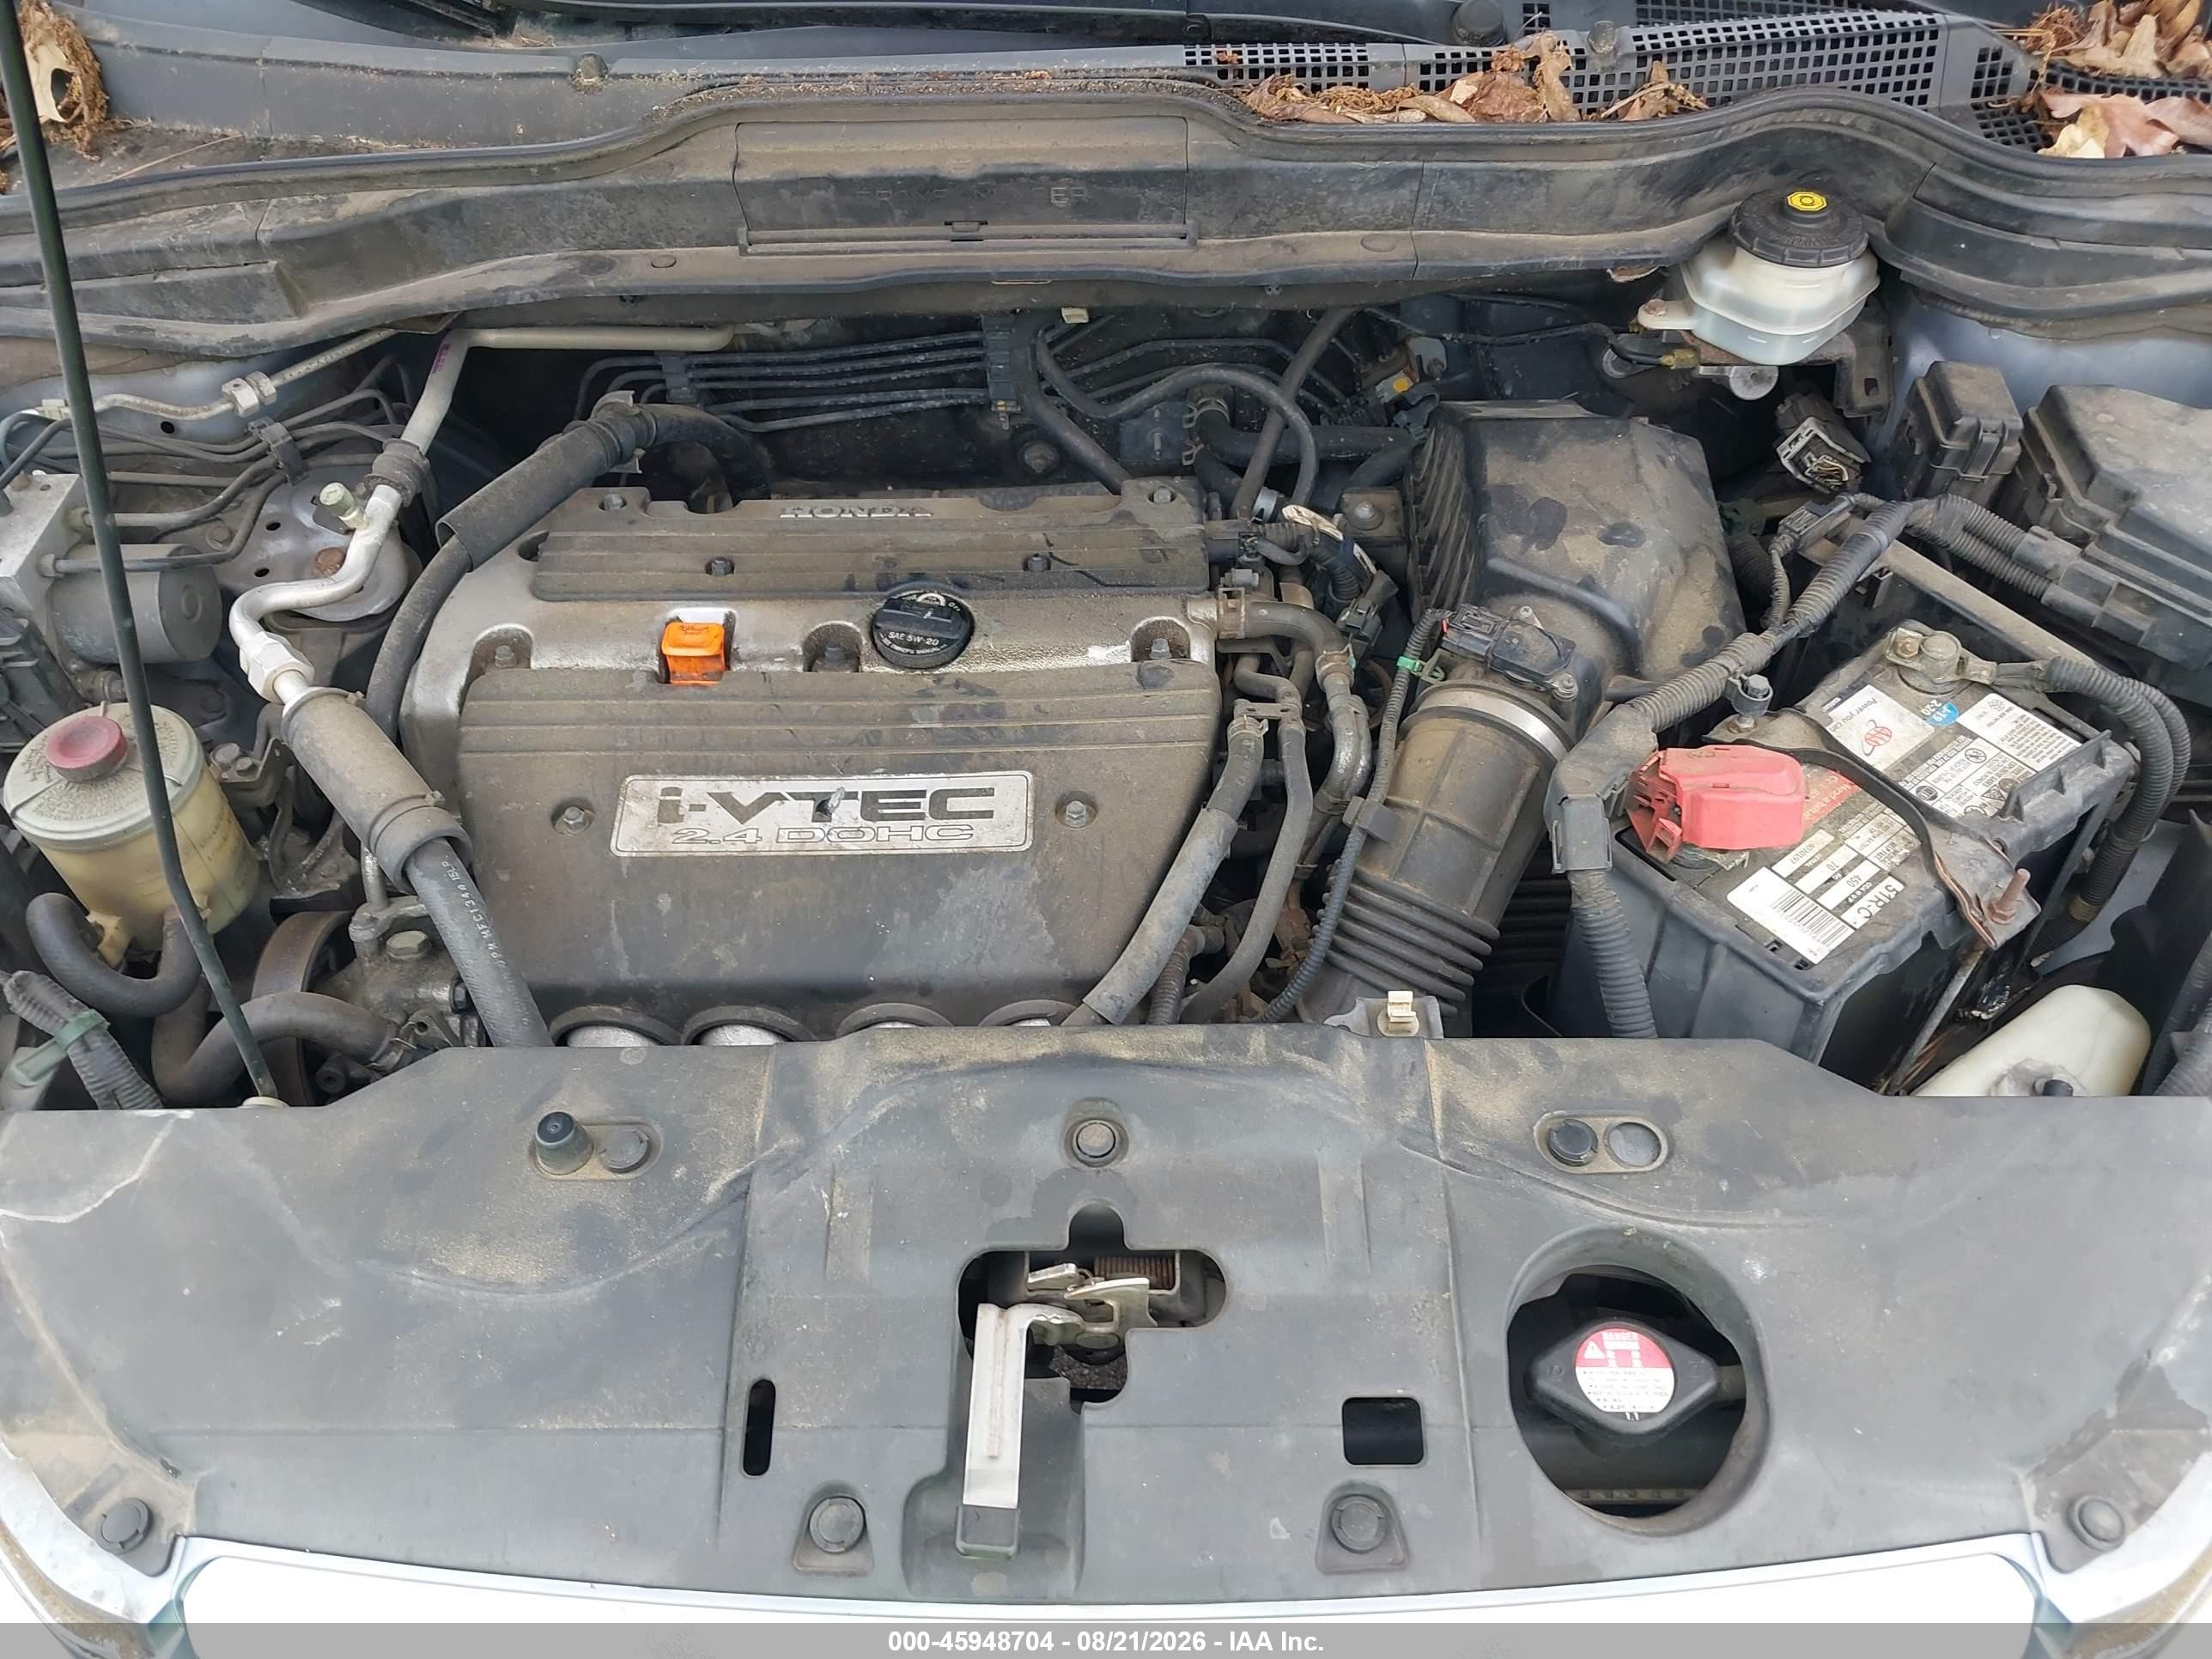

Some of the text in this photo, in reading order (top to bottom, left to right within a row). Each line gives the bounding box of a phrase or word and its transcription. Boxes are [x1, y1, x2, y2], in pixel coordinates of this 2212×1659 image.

[780, 505, 933, 519] HONDA
[888, 631, 940, 646] SAE 5W-20
[1855, 696, 1878, 714] Power
[1839, 710, 1857, 723] you
[1827, 721, 1844, 732] can
[656, 786, 995, 824] i-VTEC
[672, 823, 975, 845] 2.4 DOHC
[1825, 860, 1839, 872] 70
[1844, 873, 1863, 888] 450
[1856, 884, 1899, 920] 51R-C
